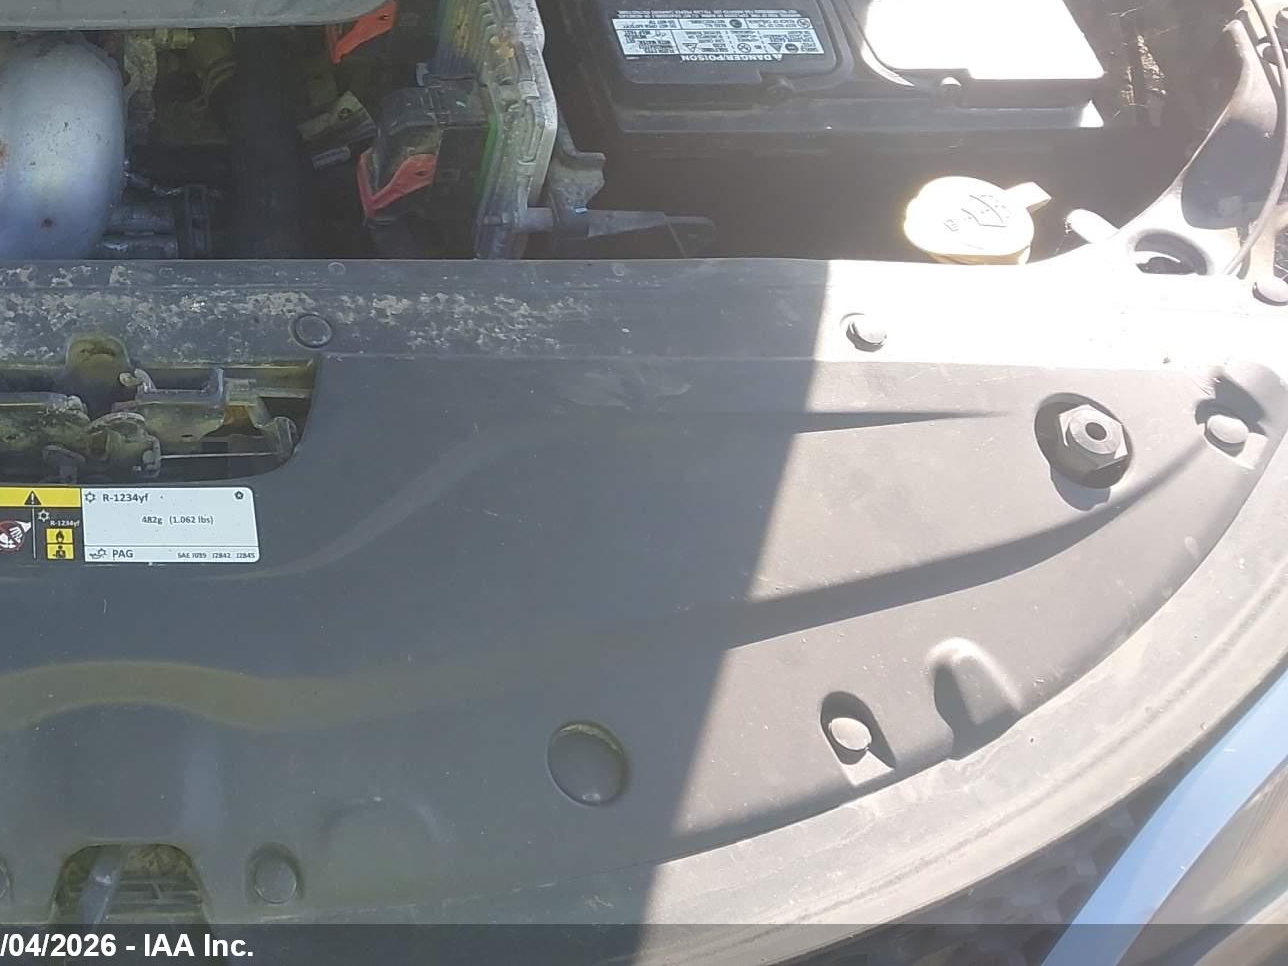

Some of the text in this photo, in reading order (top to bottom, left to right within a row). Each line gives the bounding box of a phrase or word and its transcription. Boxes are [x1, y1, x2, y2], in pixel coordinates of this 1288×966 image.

[103, 493, 149, 503] R-1234yf
[142, 515, 214, 525] 482g (1.062 lbs)
[112, 549, 134, 558] PAG
